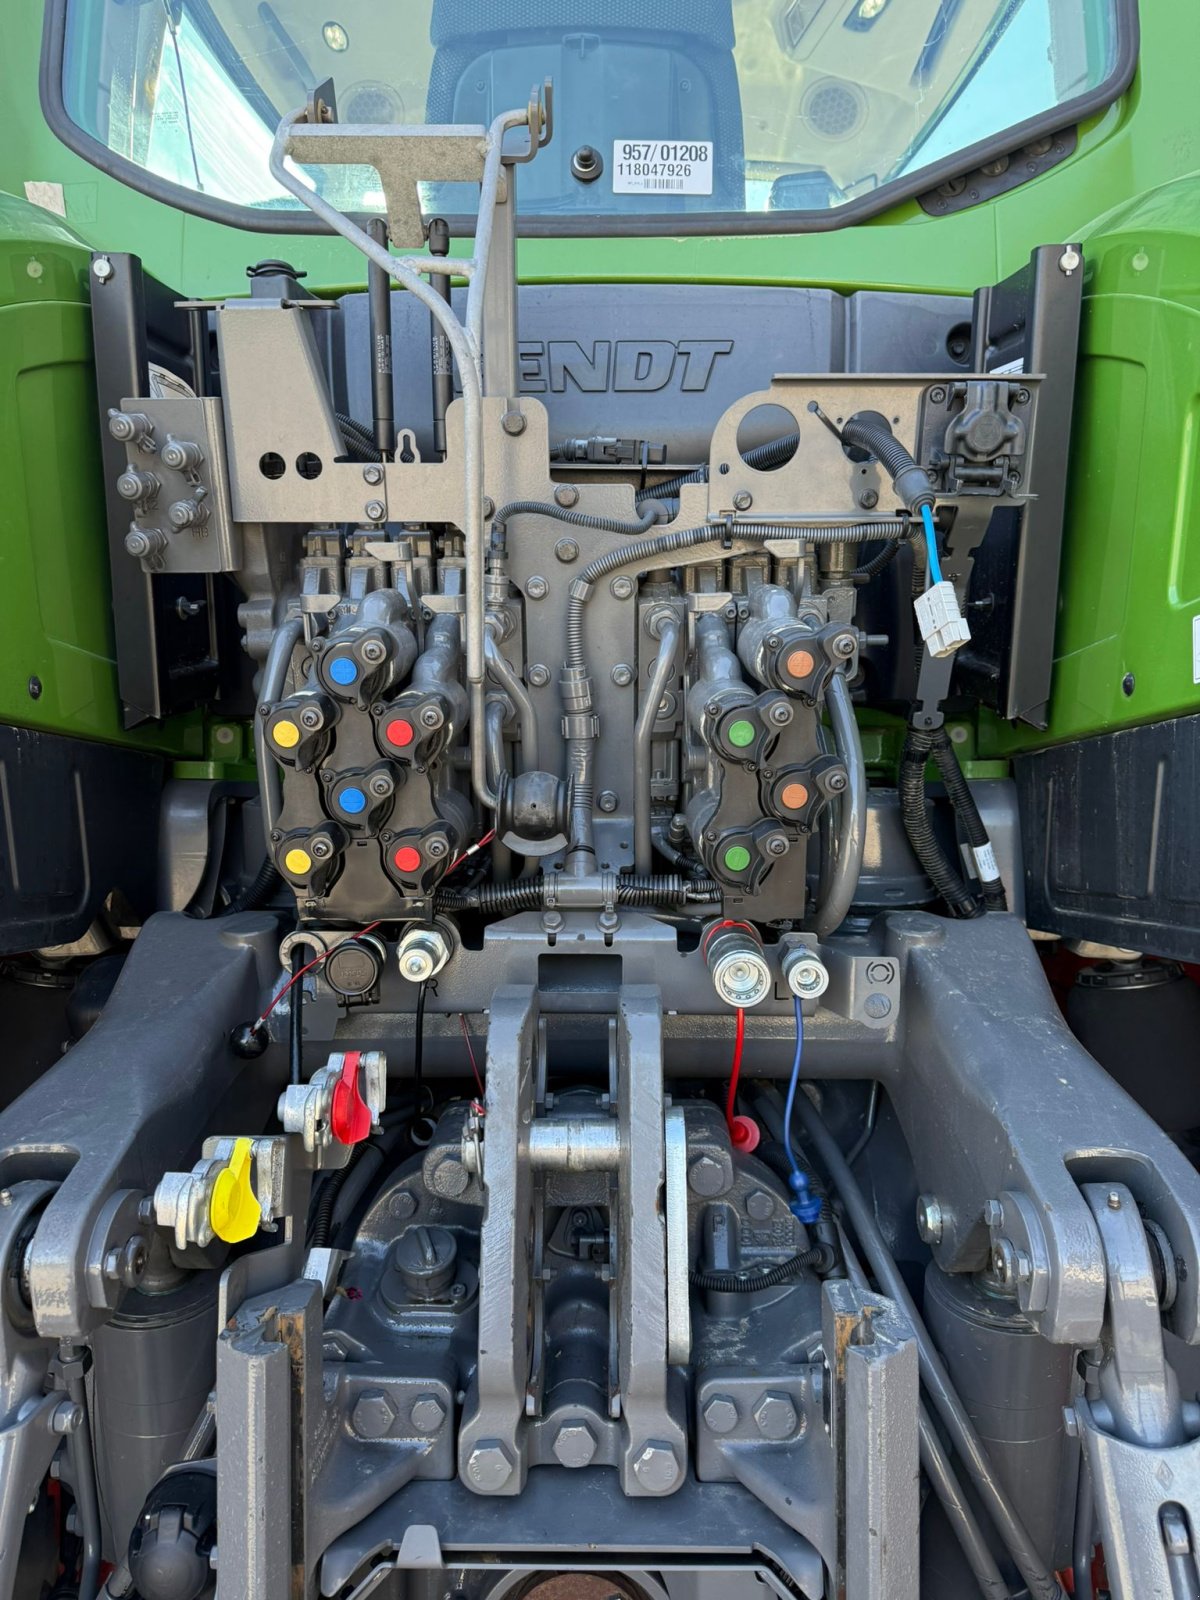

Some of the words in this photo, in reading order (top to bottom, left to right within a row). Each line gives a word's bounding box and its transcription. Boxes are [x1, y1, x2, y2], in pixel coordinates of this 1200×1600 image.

[617, 163, 692, 177] 118047926
[517, 339, 735, 393] ENDT
[774, 981, 790, 1001] L
